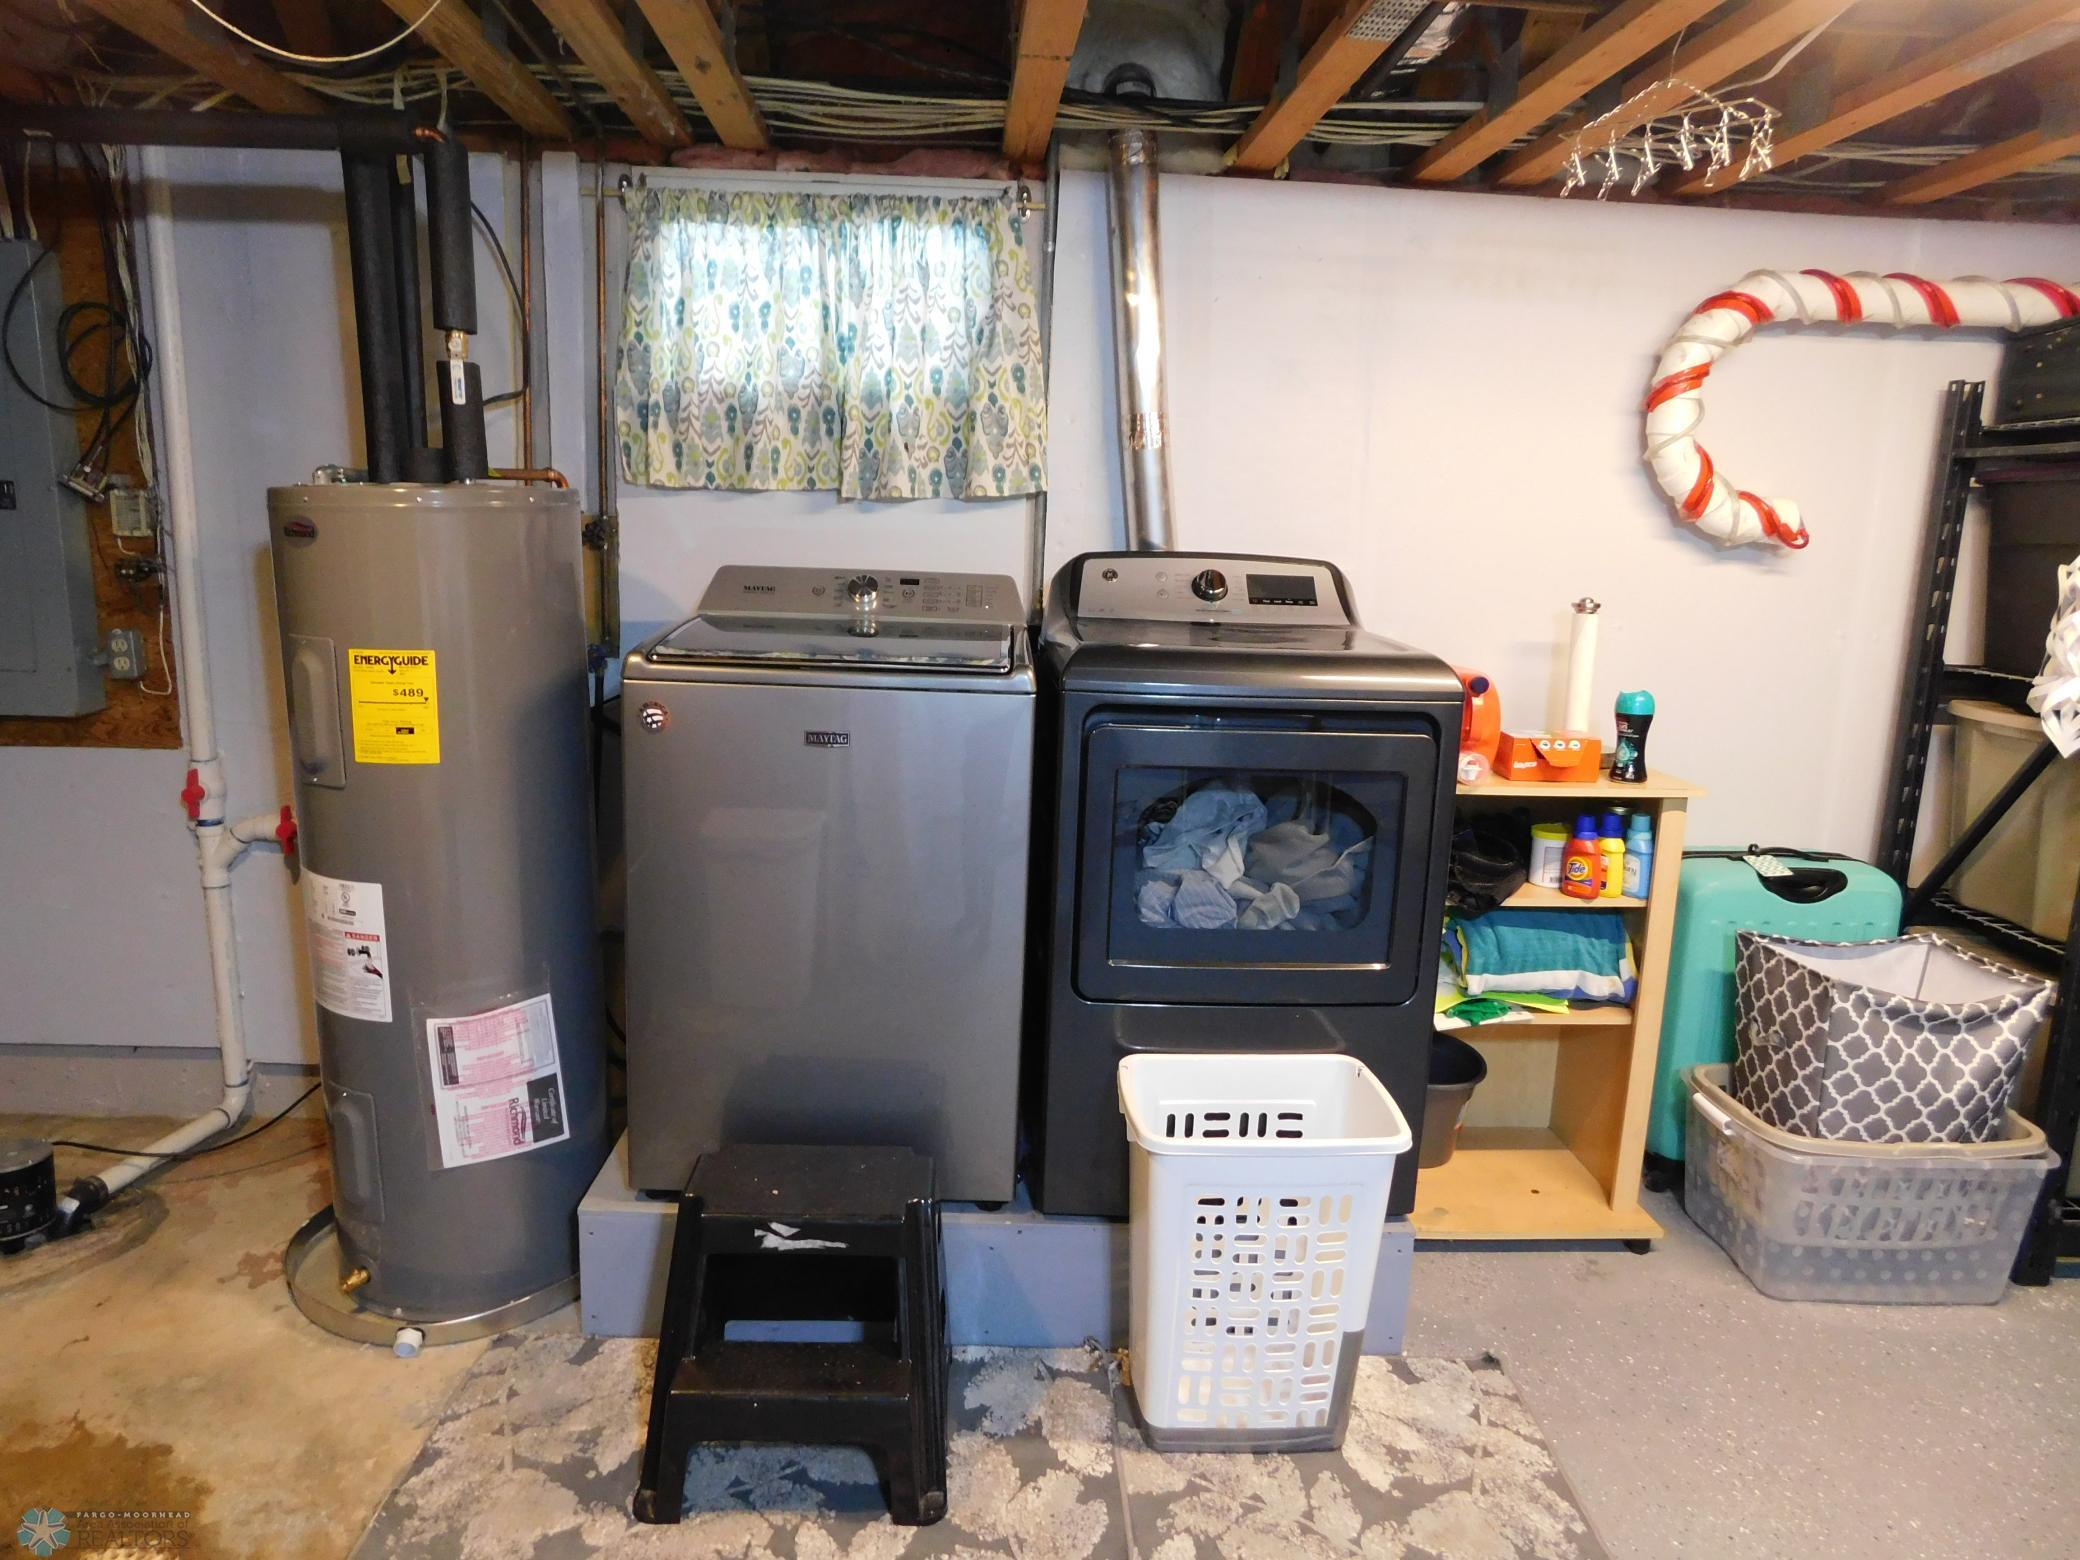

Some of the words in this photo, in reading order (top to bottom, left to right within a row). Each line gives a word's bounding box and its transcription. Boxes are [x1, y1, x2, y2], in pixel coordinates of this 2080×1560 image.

[353, 654, 428, 666] ENERGYGUIDE
[392, 688, 424, 697] $489
[807, 733, 848, 744] MAYTAG
[1569, 862, 1586, 874] Tide
[509, 1097, 525, 1146] Richmond
